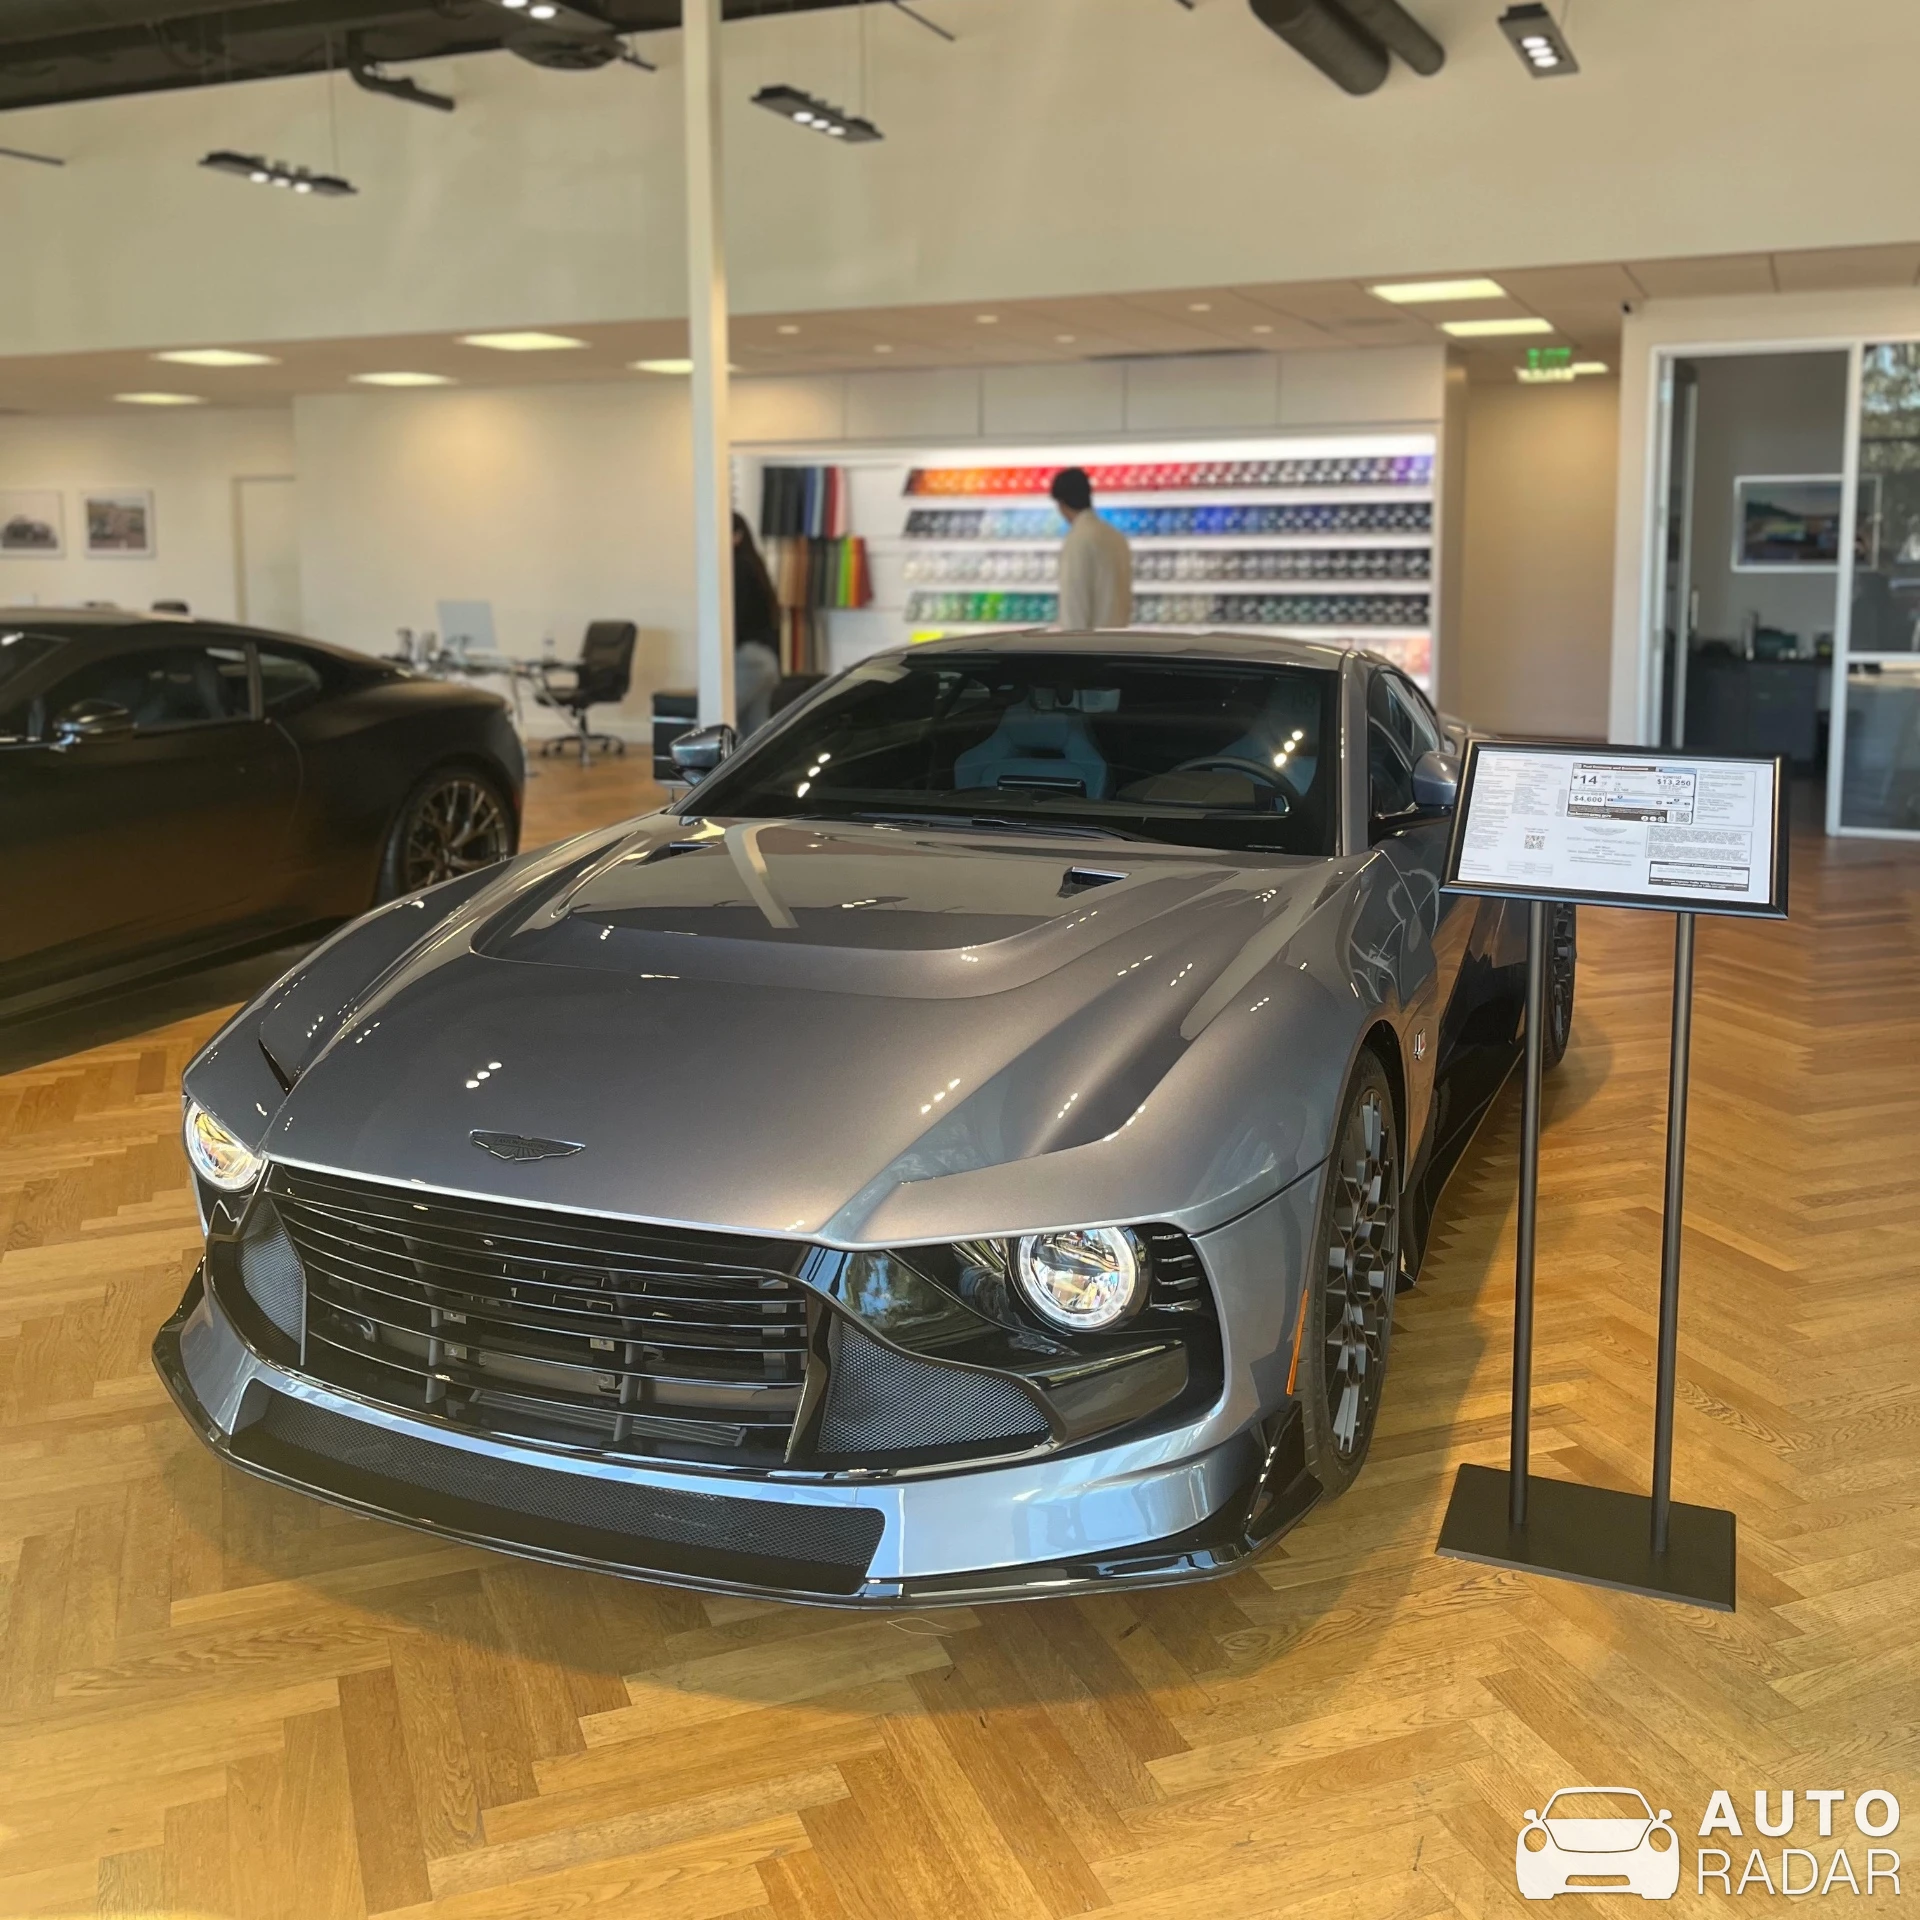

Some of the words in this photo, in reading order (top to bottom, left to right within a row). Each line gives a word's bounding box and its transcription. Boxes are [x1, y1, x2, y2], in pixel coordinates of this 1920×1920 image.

[1580, 775, 1598, 785] 14
[1657, 778, 1691, 787] $13,250
[1574, 795, 1603, 803] $4,600
